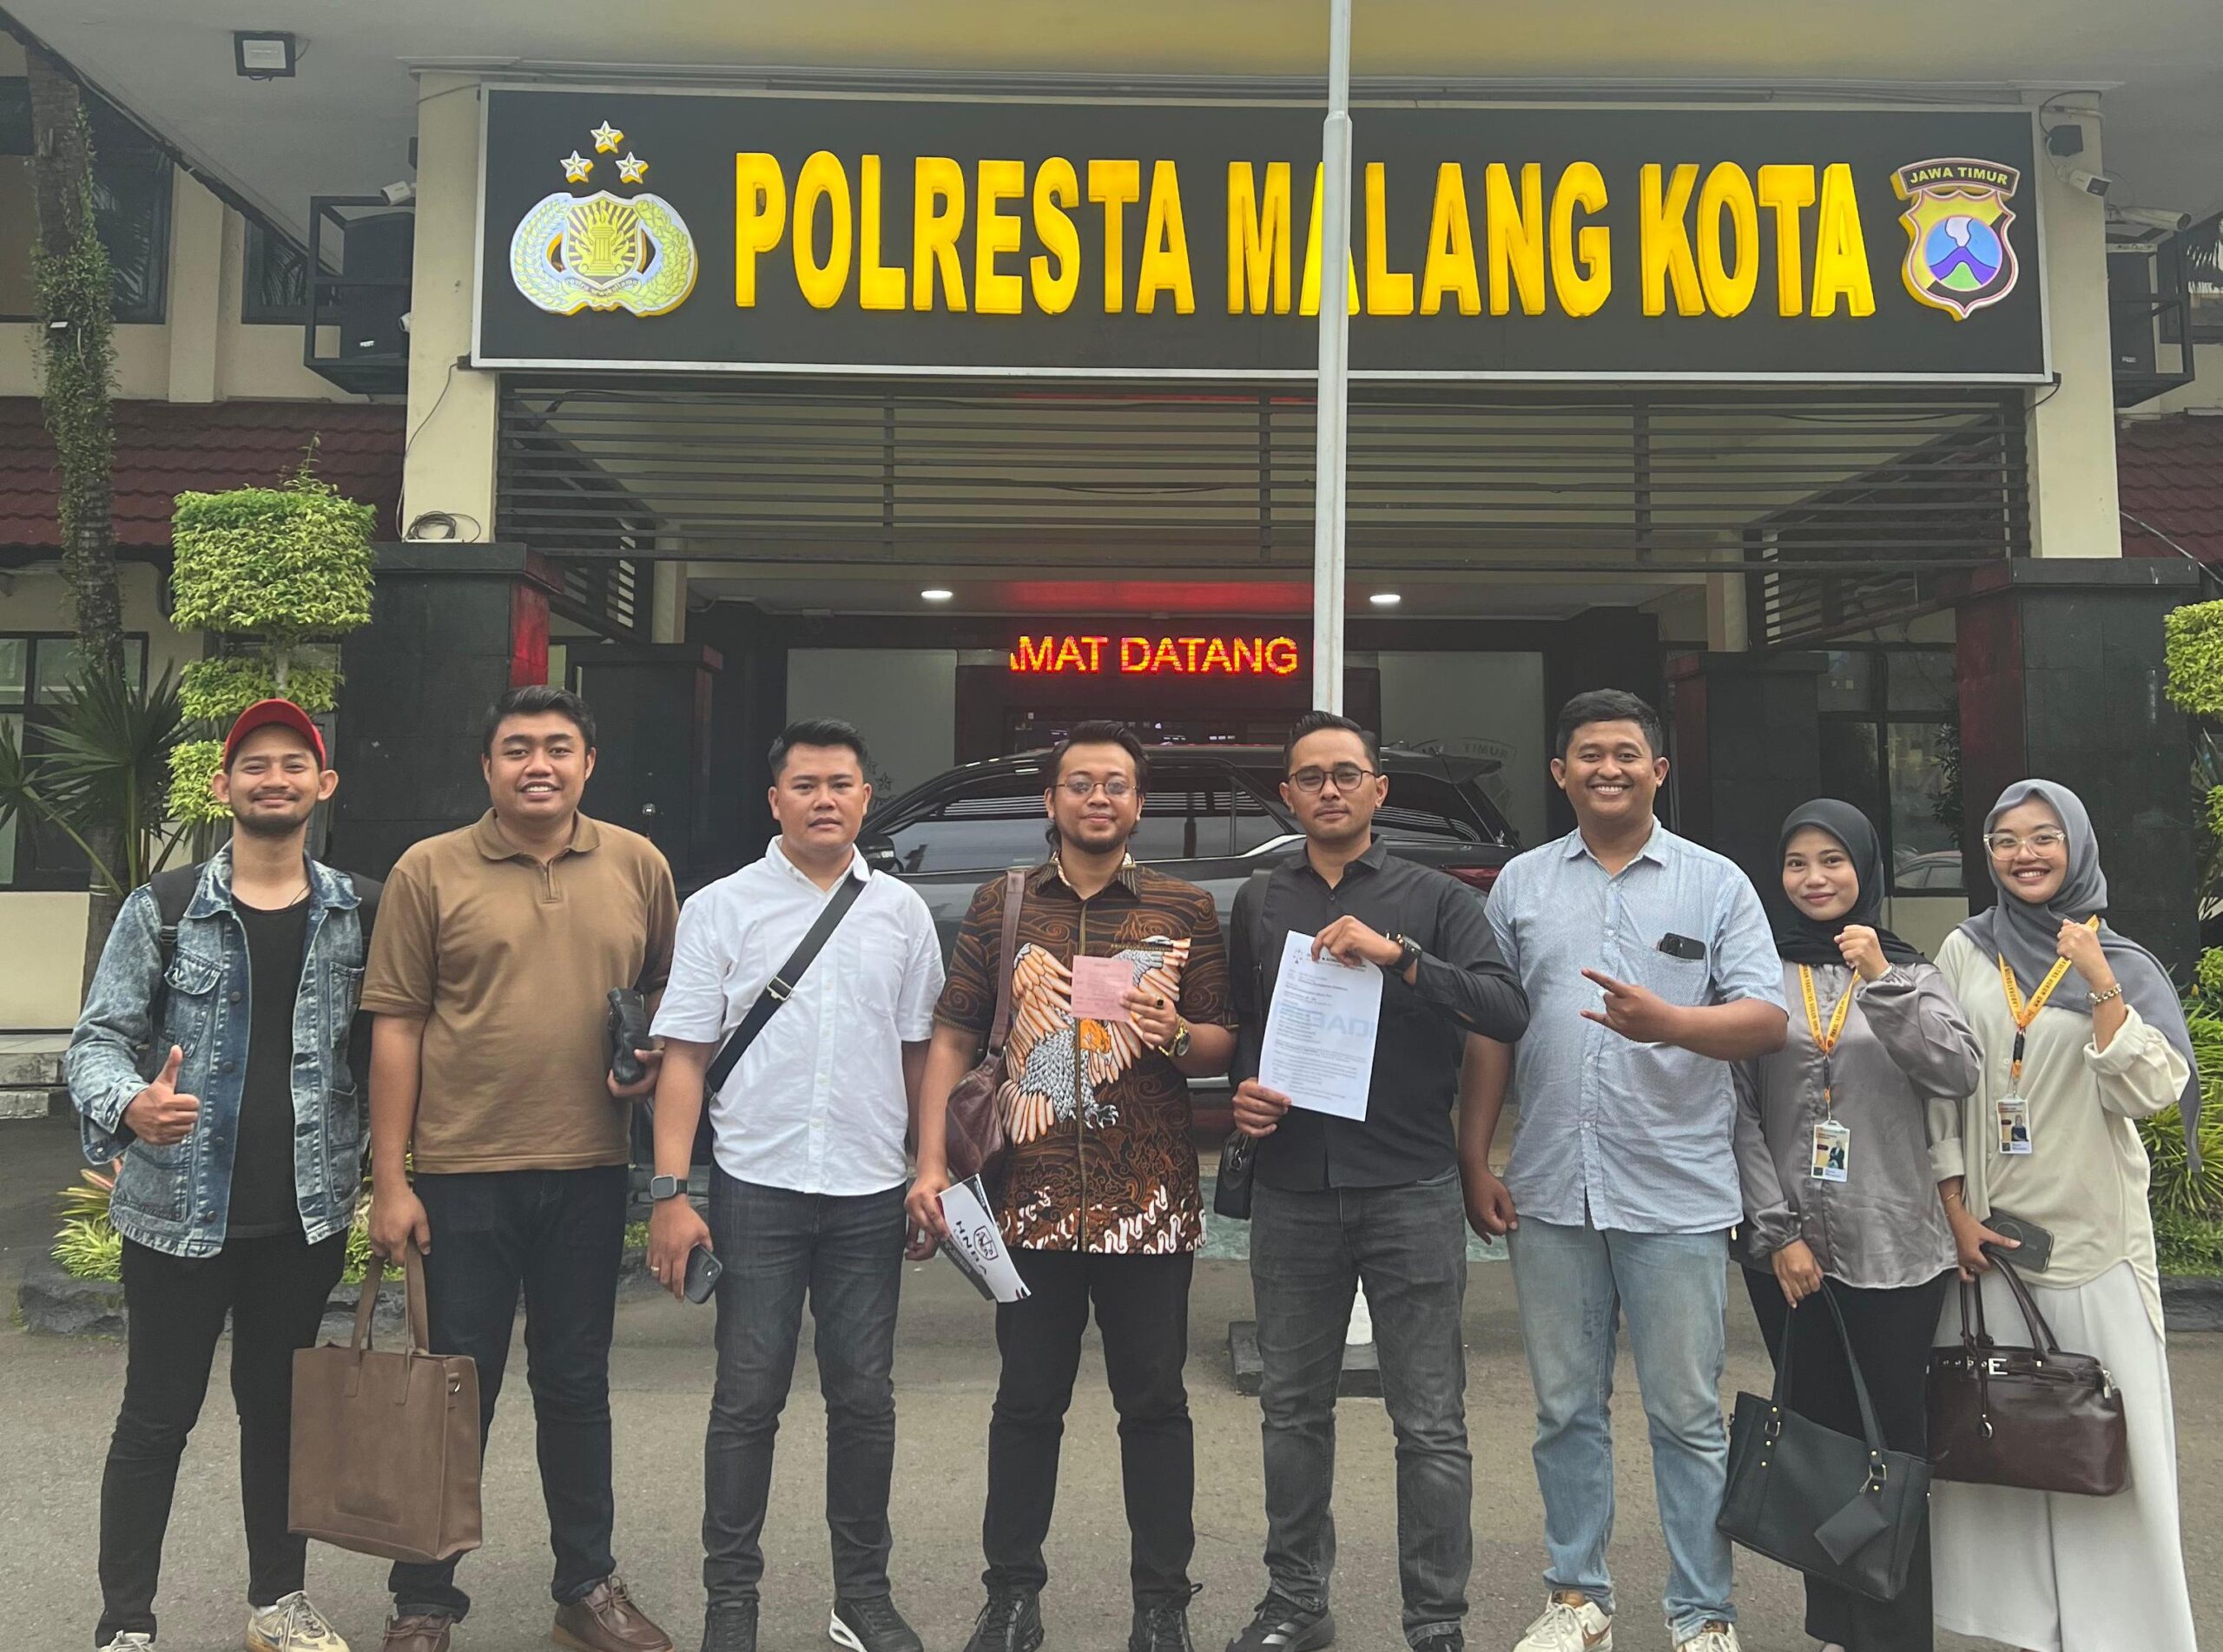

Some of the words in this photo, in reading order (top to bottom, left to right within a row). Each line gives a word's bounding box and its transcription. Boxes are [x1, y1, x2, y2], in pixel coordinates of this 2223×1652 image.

[1910, 167, 1954, 184] JAWA
[1957, 167, 2009, 186] TIMUR
[736, 151, 1196, 314] POLRESTA
[1639, 161, 1876, 318] KOTA
[1119, 636, 1299, 674] DATANG
